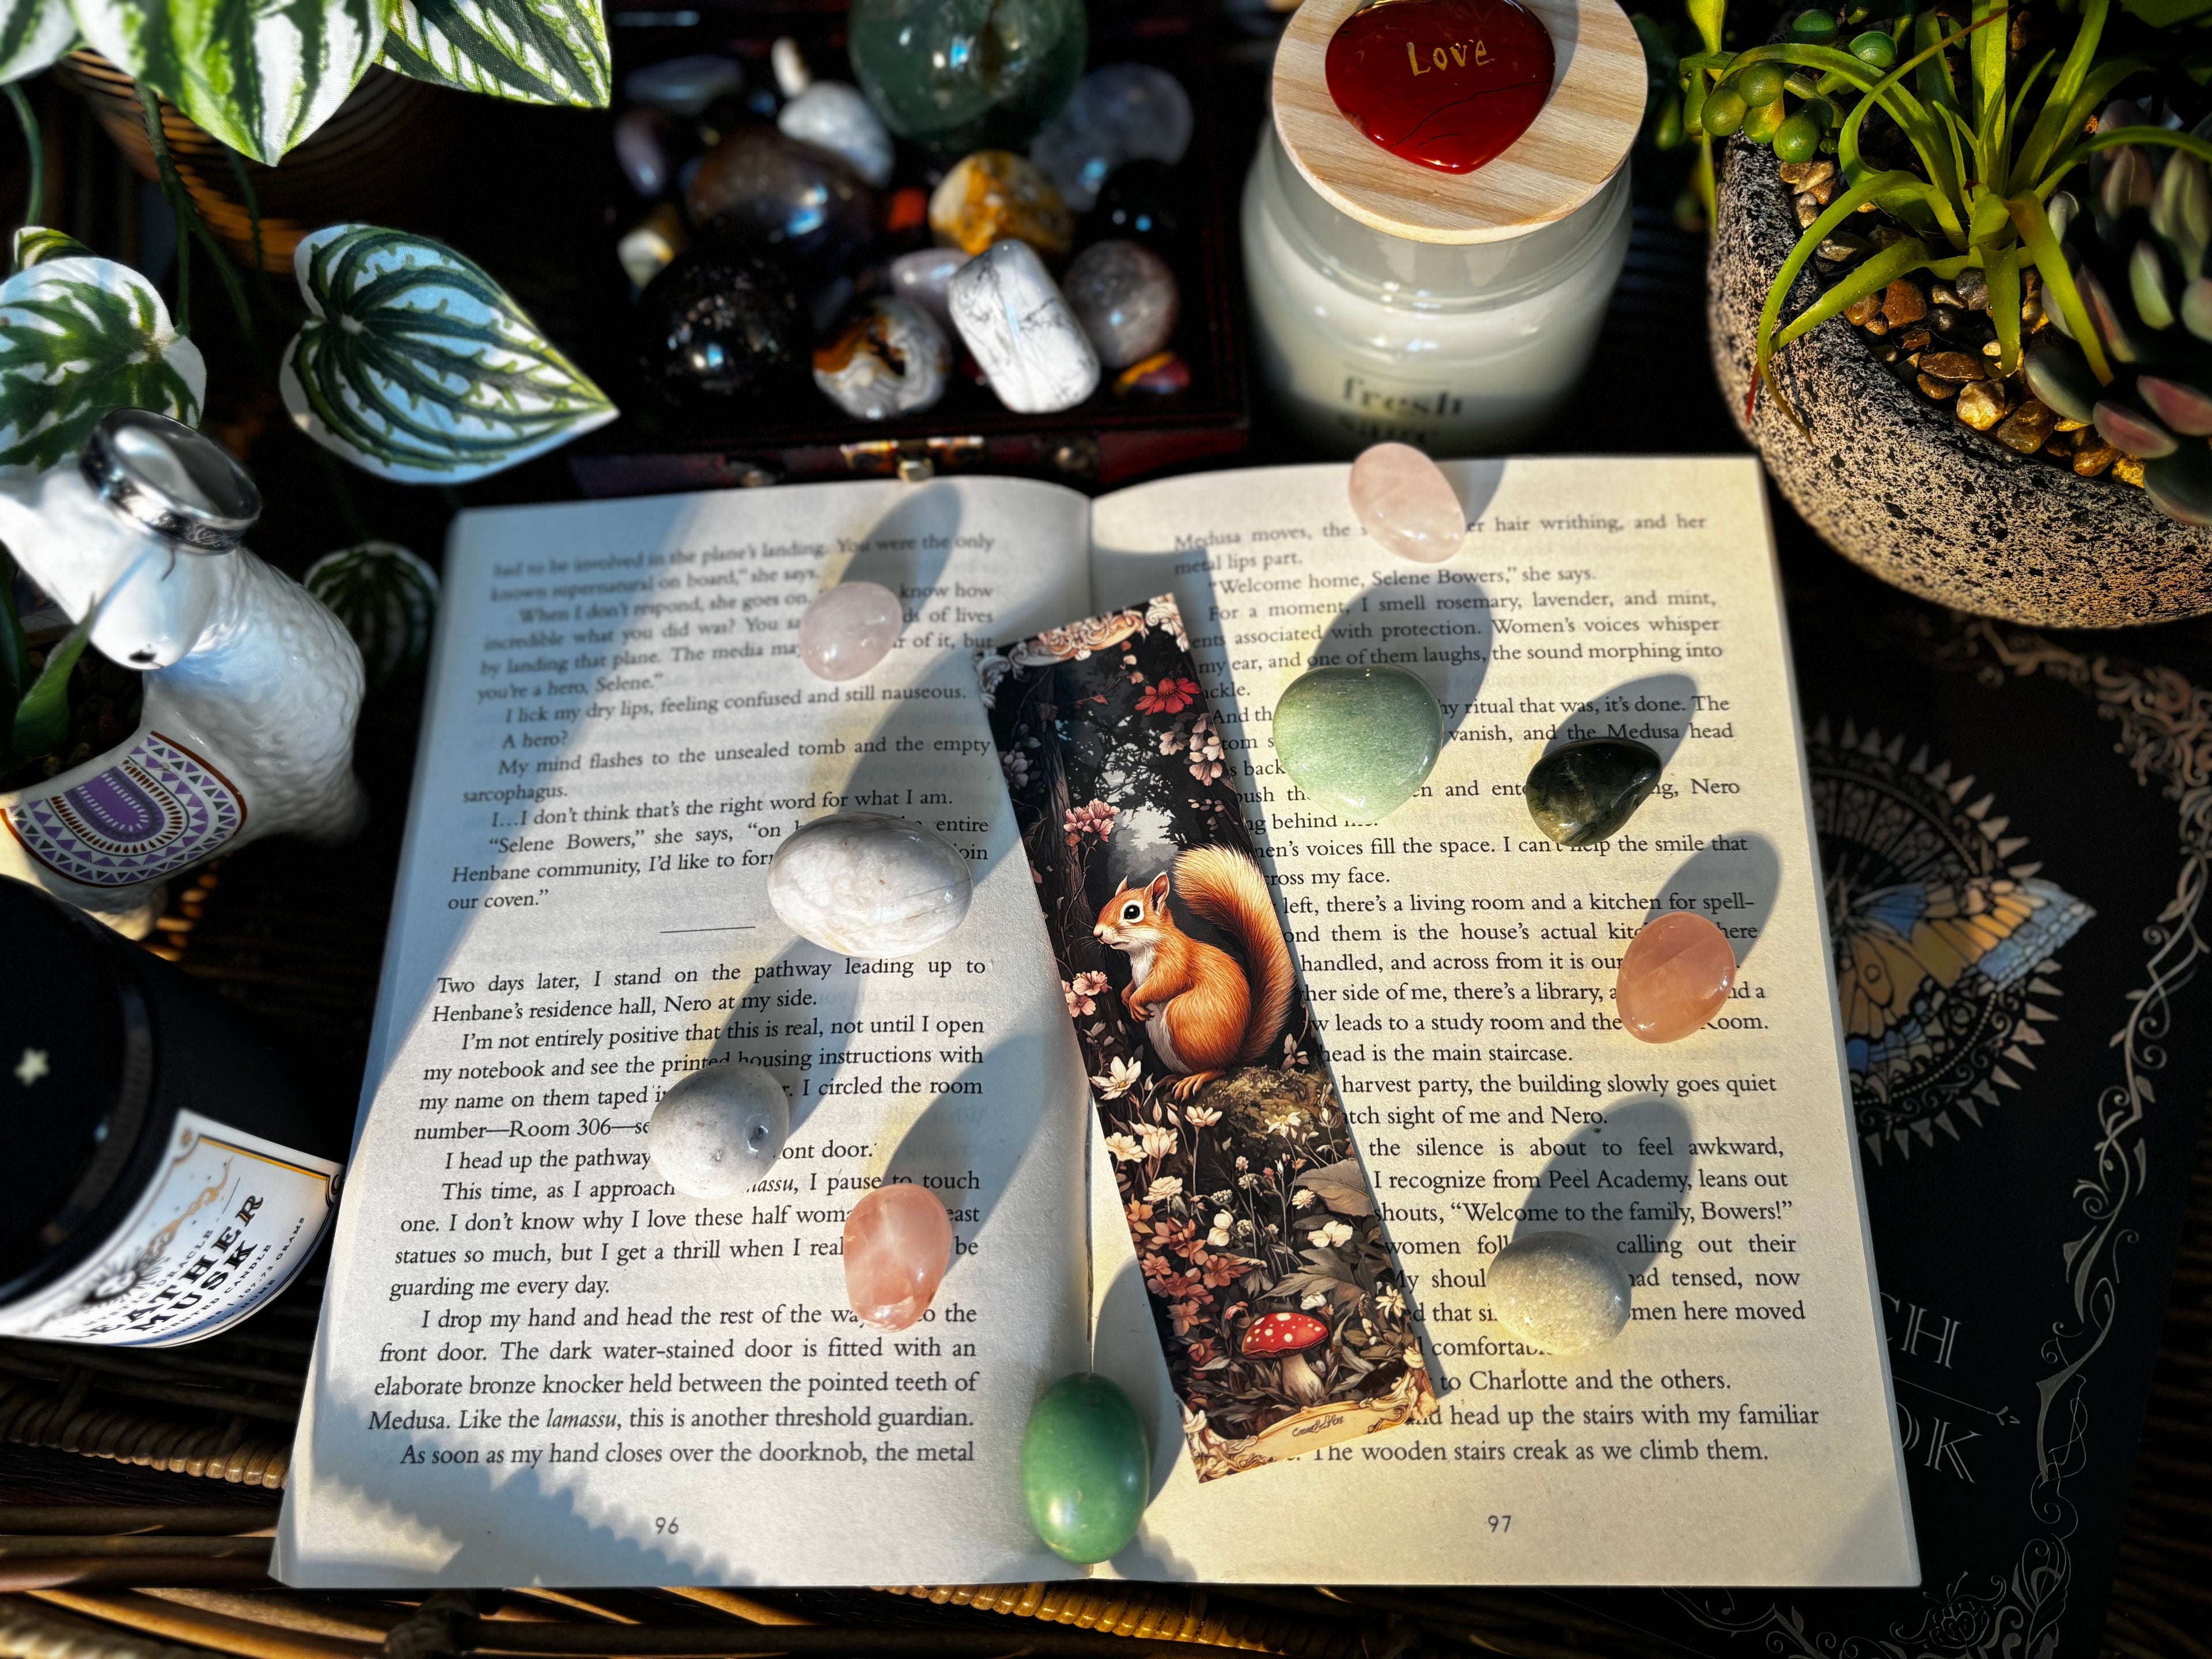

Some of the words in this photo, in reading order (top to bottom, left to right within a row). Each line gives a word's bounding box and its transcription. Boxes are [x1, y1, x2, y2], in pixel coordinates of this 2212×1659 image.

[1407, 40, 1495, 76] Love
[1208, 605, 1239, 622] For
[1248, 607, 1258, 618] a
[1268, 601, 1351, 617] moment,
[1361, 596, 1369, 613] I
[1378, 594, 1427, 612] smell
[1435, 596, 1522, 612] rosemary,
[1531, 590, 1615, 608] lavender,
[1624, 589, 1658, 606] and
[1667, 593, 1717, 607] mint,
[505, 709, 513, 724] I
[518, 706, 548, 722] lick
[554, 706, 580, 723] my
[585, 702, 615, 718] dry
[620, 700, 654, 721] lips,
[660, 695, 719, 714] feeling
[724, 688, 802, 709] confused
[807, 686, 840, 704] and
[844, 684, 876, 702] still
[881, 687, 967, 701] nauseous.
[498, 759, 529, 778] My
[536, 754, 581, 772] mind
[589, 752, 643, 769] flashes
[652, 753, 670, 765] to
[679, 747, 706, 764] the
[715, 740, 789, 761] unsealed
[798, 738, 846, 756] tomb
[854, 736, 887, 753] and
[895, 735, 924, 752] the
[933, 739, 991, 756] empty
[1282, 896, 1319, 916] left,
[1326, 895, 1387, 913] there’s
[1393, 900, 1404, 912] a
[1409, 893, 1466, 916] living
[1471, 898, 1525, 911] room
[1531, 892, 1567, 911] and
[1573, 898, 1584, 910] a
[1588, 892, 1663, 910] kitchen
[1668, 892, 1697, 910] for
[1703, 892, 1755, 915] spell-
[437, 977, 475, 994] Two
[488, 974, 524, 996] days
[536, 972, 579, 991] later,
[593, 970, 602, 987] I
[614, 967, 661, 986] stand
[675, 970, 699, 983] on
[711, 963, 741, 981] the
[753, 959, 832, 984] pathway
[844, 957, 914, 979] leading
[927, 960, 952, 979] up
[965, 960, 986, 974] to
[1341, 1074, 1412, 1093] harvest
[1418, 1078, 1473, 1099] party,
[1479, 1073, 1512, 1093] the
[1517, 1073, 1602, 1098] building
[1607, 1073, 1670, 1098] slowly
[1676, 1079, 1720, 1098] goes
[1726, 1073, 1777, 1097] quiet
[445, 1152, 454, 1170] I
[459, 1150, 503, 1169] head
[509, 1155, 533, 1173] up
[539, 1149, 569, 1168] the
[573, 1147, 651, 1172] pathway
[1368, 1137, 1401, 1157] the
[1416, 1137, 1484, 1157] silence
[1499, 1137, 1514, 1156] is
[1529, 1137, 1587, 1157] about
[1601, 1141, 1622, 1156] to
[1637, 1136, 1675, 1156] feel
[1688, 1135, 1784, 1158] awkward,
[1373, 1170, 1382, 1189] I
[1388, 1169, 1486, 1194] recognize
[1492, 1169, 1542, 1189] from
[1547, 1169, 1590, 1189] Peel
[1596, 1168, 1692, 1194] Academy,
[1697, 1168, 1748, 1188] leans
[1754, 1172, 1789, 1187] out
[1373, 1202, 1445, 1225] shouts,
[1450, 1201, 1559, 1222] “Welcome
[1564, 1206, 1585, 1222] to
[1590, 1201, 1623, 1222] the
[1628, 1200, 1695, 1226] family,
[1699, 1200, 1793, 1220] Bowers!”
[276, 1217, 305, 1260] GRAMS
[61, 1195, 264, 1339] LEATHER
[156, 1229, 214, 1288] ORACLE
[124, 1240, 258, 1332] MUSK
[151, 1297, 221, 1334] SCENTED
[224, 1244, 272, 1294] CANDLE
[240, 1279, 276, 1309] HOME
[378, 1342, 428, 1362] front
[437, 1341, 487, 1361] door.
[500, 1340, 540, 1361] The
[549, 1340, 592, 1360] dark
[603, 1338, 734, 1359] water-stained
[744, 1338, 793, 1358] door
[802, 1338, 817, 1357] is
[828, 1336, 883, 1357] fitted
[893, 1336, 942, 1357] with
[952, 1343, 977, 1357] an
[374, 1375, 463, 1396] elaborate
[469, 1374, 536, 1395] bronze
[541, 1373, 624, 1394] knocker
[628, 1373, 672, 1393] held
[679, 1372, 763, 1393] between
[770, 1371, 801, 1392] the
[807, 1370, 889, 1398] pointed
[895, 1370, 948, 1392] teeth
[955, 1370, 980, 1392] of
[1440, 1375, 1462, 1391] to
[1469, 1368, 1568, 1391] Charlotte
[1575, 1369, 1613, 1390] and
[1619, 1369, 1653, 1389] the
[1660, 1368, 1731, 1389] others.
[367, 1409, 450, 1430] Medusa.
[457, 1408, 502, 1429] Like
[508, 1408, 540, 1429] the
[546, 1407, 622, 1431] lamassu,
[630, 1407, 664, 1427] this
[670, 1407, 685, 1427] is
[691, 1406, 770, 1427] another
[775, 1406, 872, 1427] threshold
[877, 1406, 974, 1433] guardian.
[1449, 1404, 1501, 1425] head
[1507, 1410, 1533, 1431] up
[1541, 1403, 1575, 1425] the
[1583, 1404, 1634, 1425] stairs
[1641, 1403, 1691, 1425] with
[1697, 1410, 1731, 1431] my
[1738, 1403, 1820, 1425] familiar
[399, 1444, 426, 1464] As
[431, 1450, 479, 1464] soon
[486, 1449, 505, 1464] as
[510, 1449, 544, 1469] my
[548, 1442, 599, 1463] hand
[605, 1441, 662, 1463] closes
[669, 1448, 714, 1462] over
[720, 1441, 752, 1462] the
[759, 1440, 868, 1465] doorknob,
[876, 1440, 910, 1461] the
[916, 1440, 975, 1461] metal
[656, 1517, 679, 1535] 96
[1488, 1515, 1512, 1533] 97
